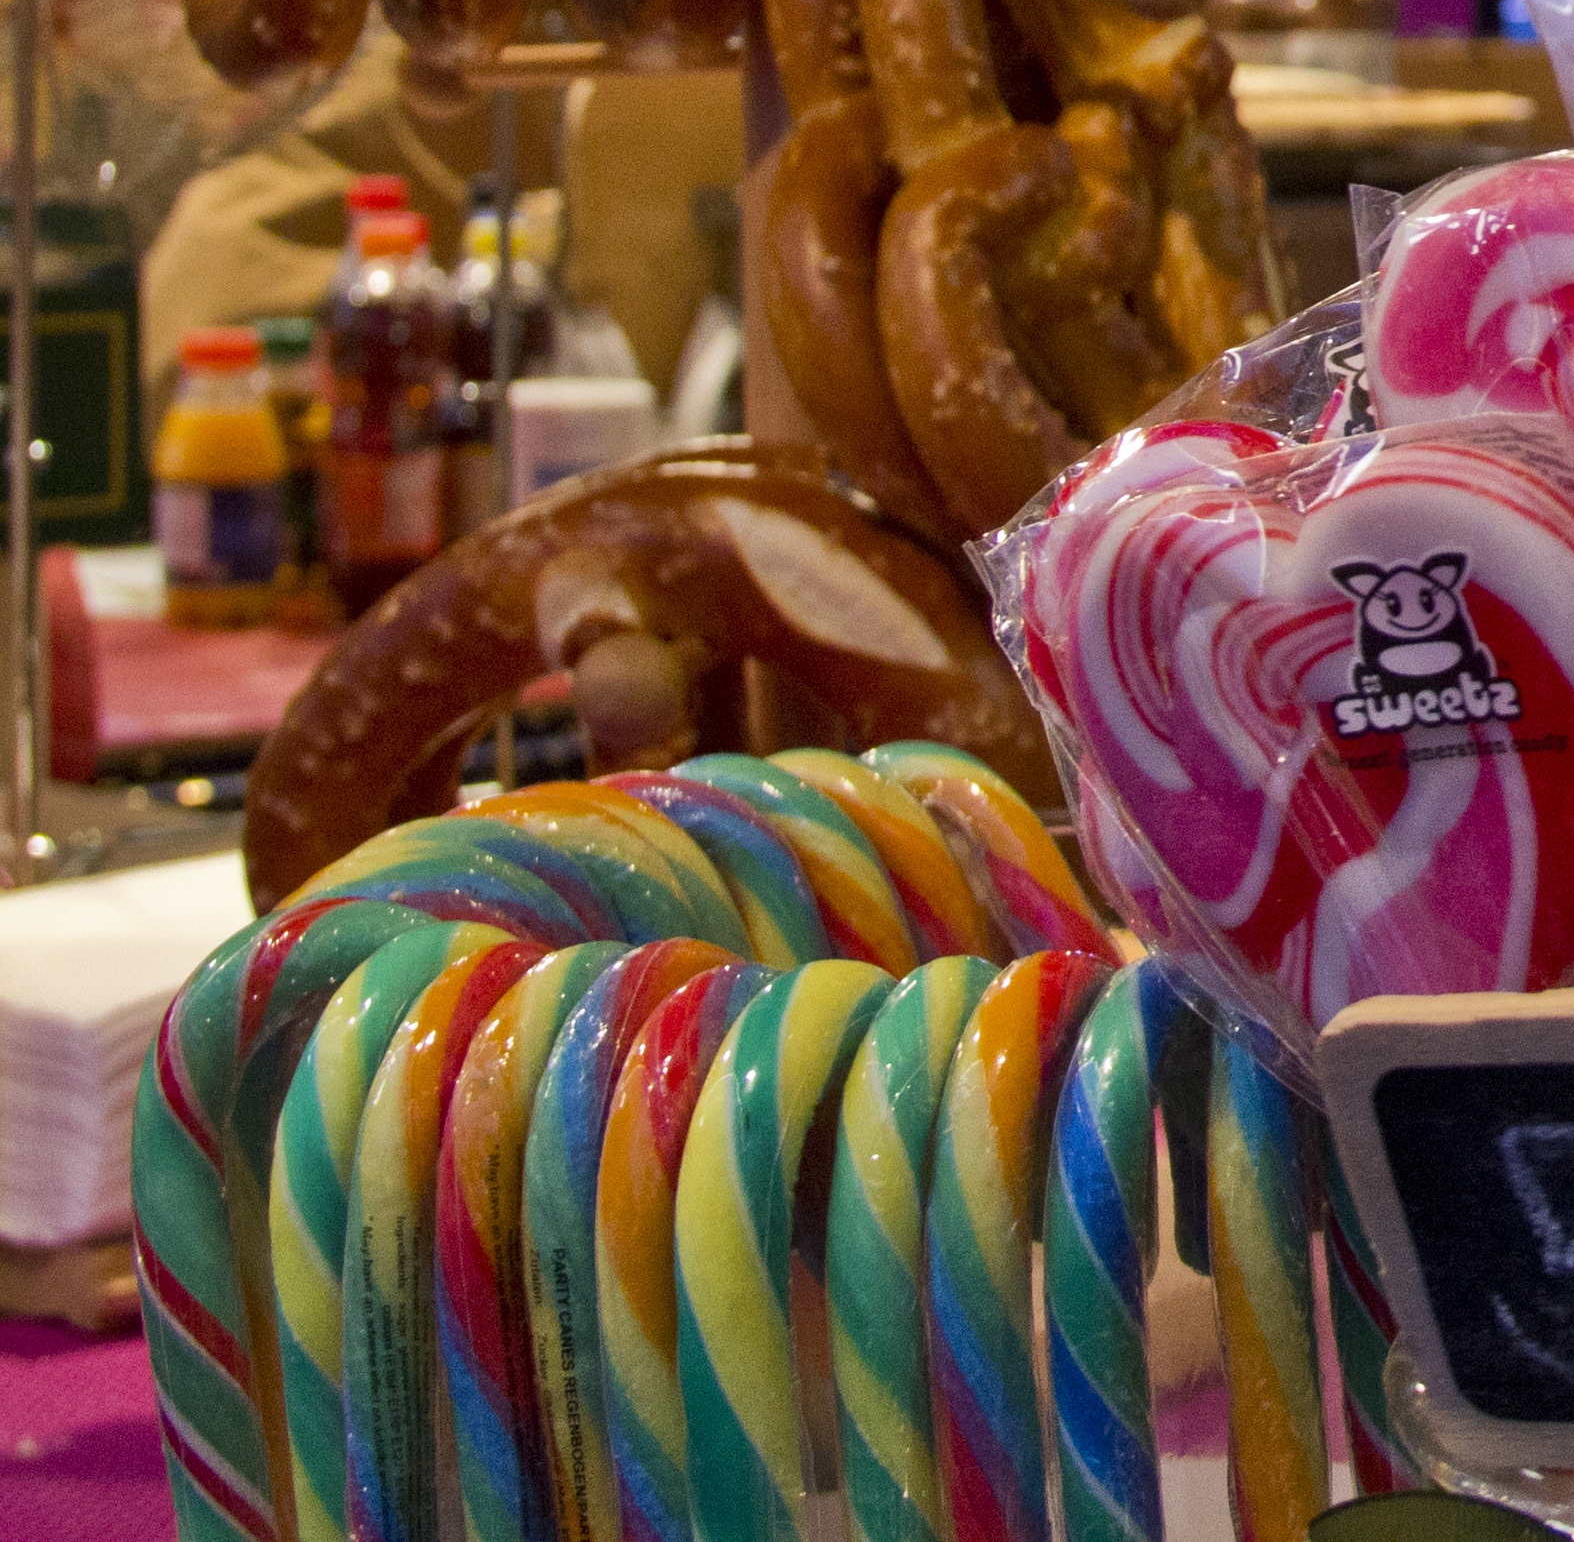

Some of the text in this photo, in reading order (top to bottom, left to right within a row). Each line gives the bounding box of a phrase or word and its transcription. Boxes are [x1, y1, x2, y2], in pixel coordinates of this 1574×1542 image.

[1333, 670, 1522, 738] sweetz
[553, 1247, 571, 1306] PARTY
[558, 1311, 575, 1371] CANES
